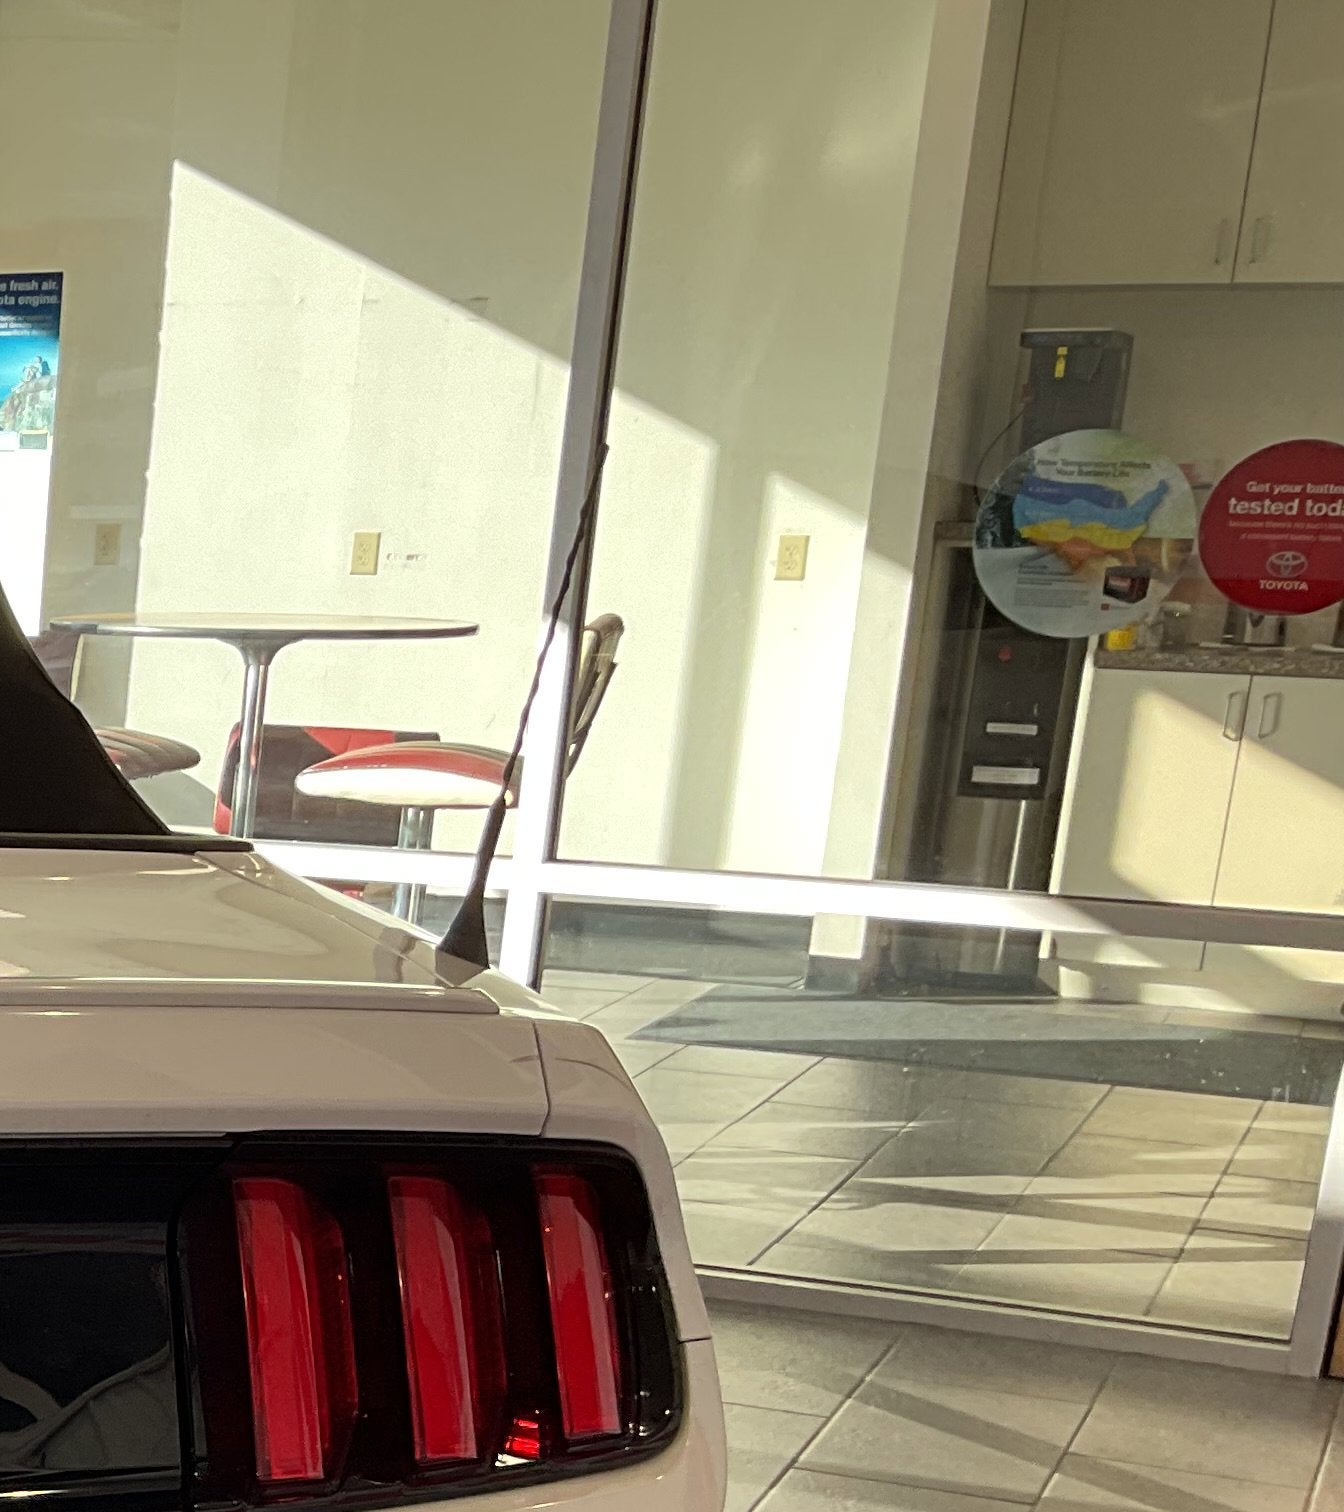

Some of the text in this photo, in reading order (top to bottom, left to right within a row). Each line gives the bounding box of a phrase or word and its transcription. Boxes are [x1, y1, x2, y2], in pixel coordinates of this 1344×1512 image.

[10, 280, 38, 292] fresh
[41, 280, 59, 290] air.
[1247, 481, 1344, 495] Get your batte
[1228, 497, 1300, 515] tested
[1259, 580, 1309, 591] TOYOTA
